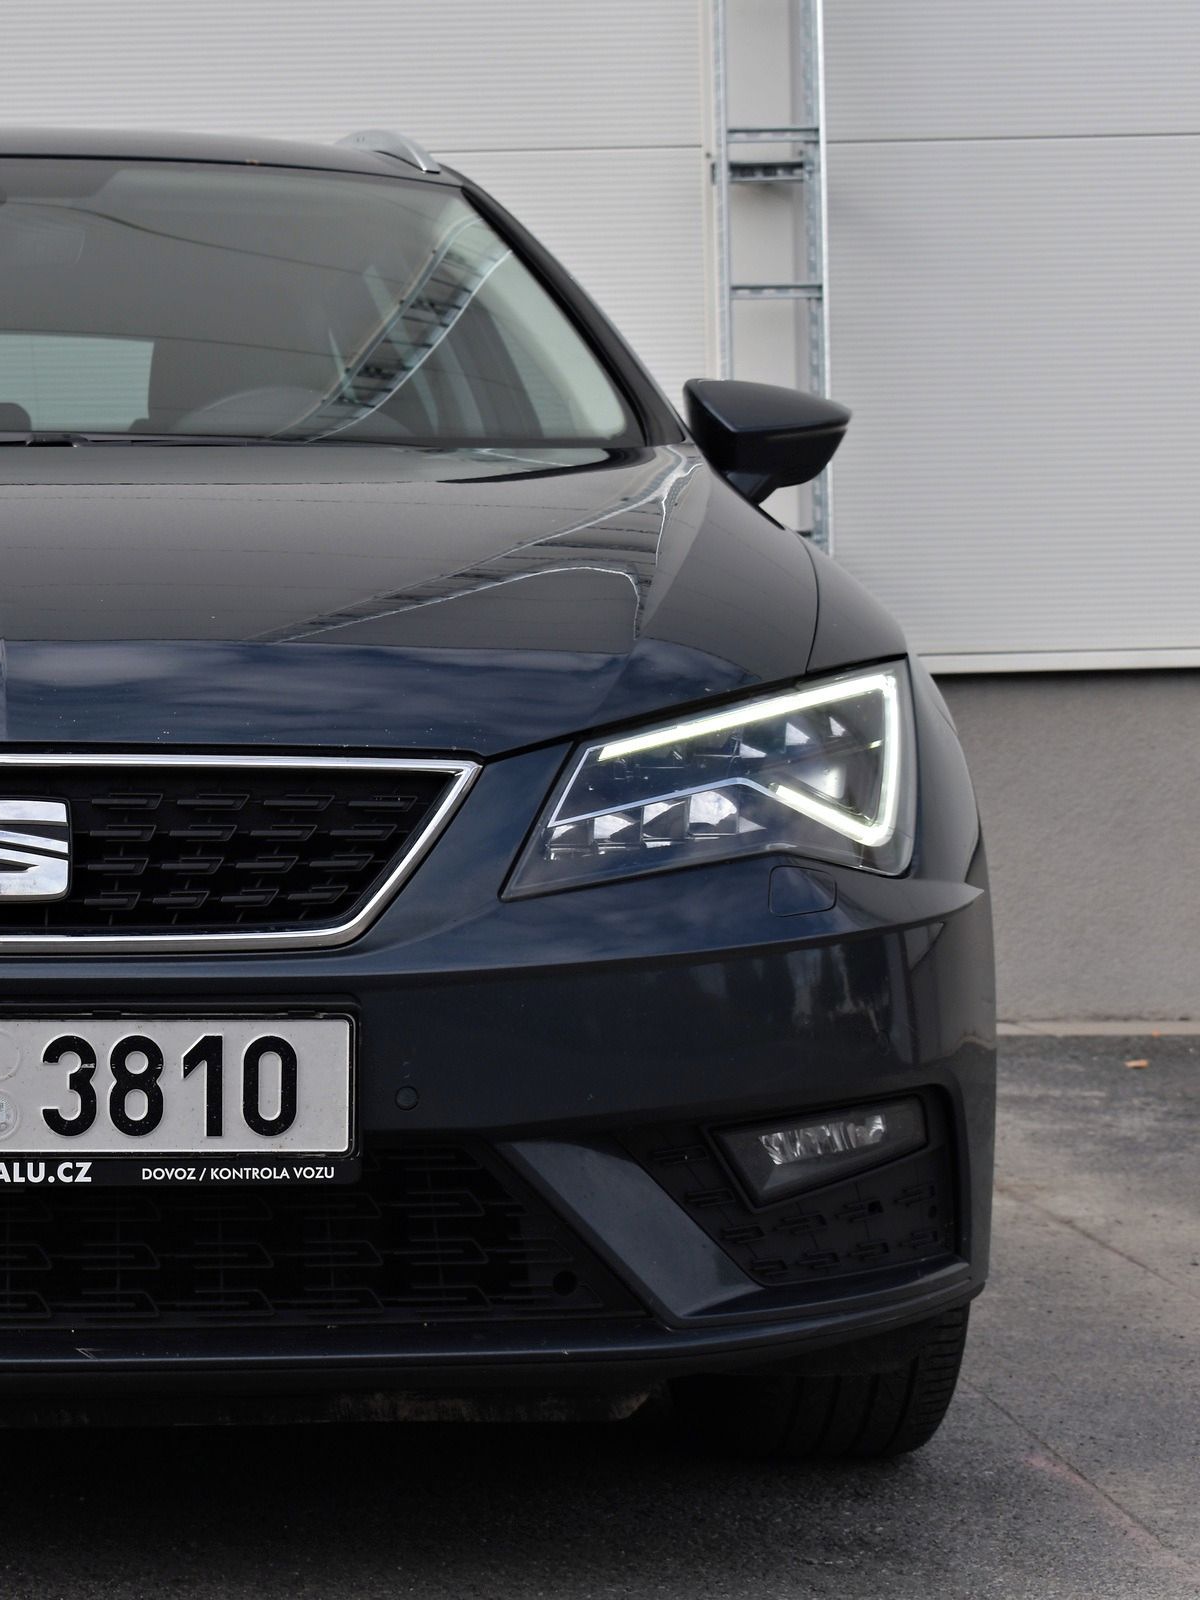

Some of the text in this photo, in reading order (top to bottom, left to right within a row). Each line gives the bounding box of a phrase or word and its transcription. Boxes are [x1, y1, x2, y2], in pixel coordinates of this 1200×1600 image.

[41, 1035, 299, 1137] 3810
[141, 1166, 335, 1182] DOVOZ / KONTROLA VOZU
